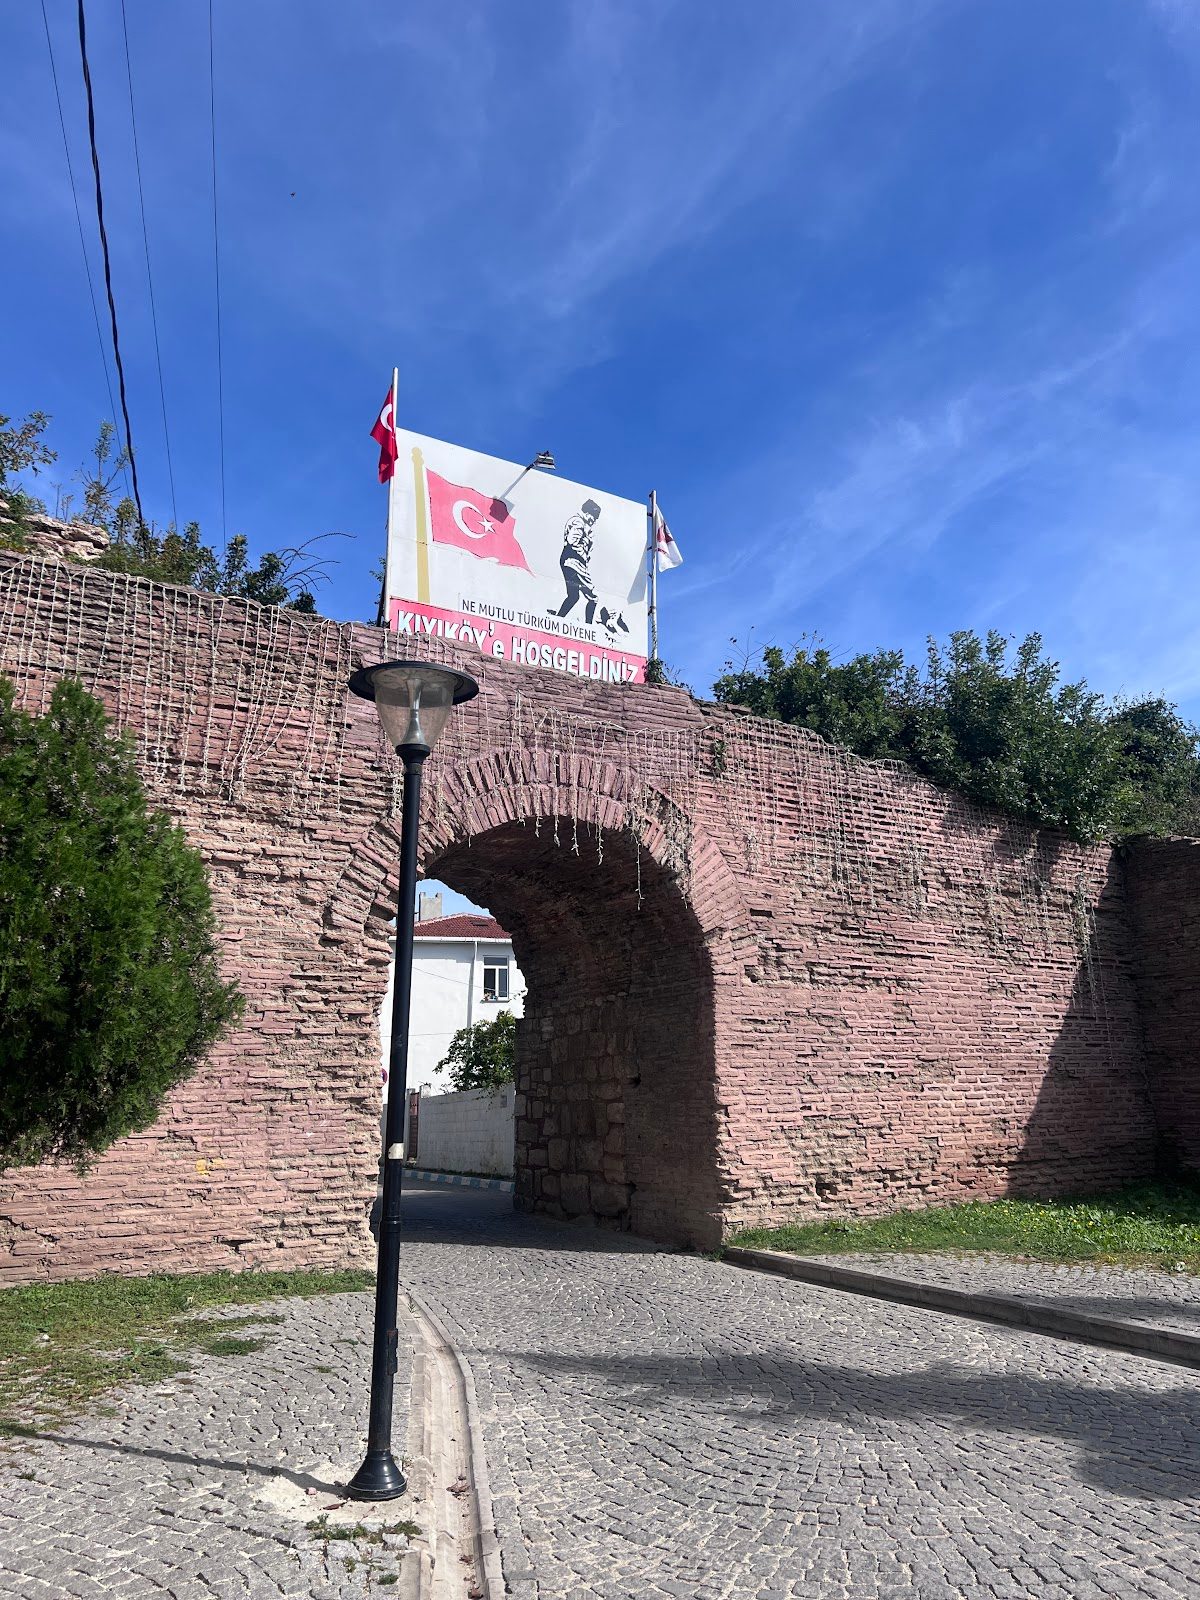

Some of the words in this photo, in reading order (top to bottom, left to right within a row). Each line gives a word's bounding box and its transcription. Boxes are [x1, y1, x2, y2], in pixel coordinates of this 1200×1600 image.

[462, 599, 475, 610] NE
[478, 603, 515, 621] MUTLU
[517, 611, 560, 632] TÜRKÜM
[562, 622, 597, 641] DİYENE
